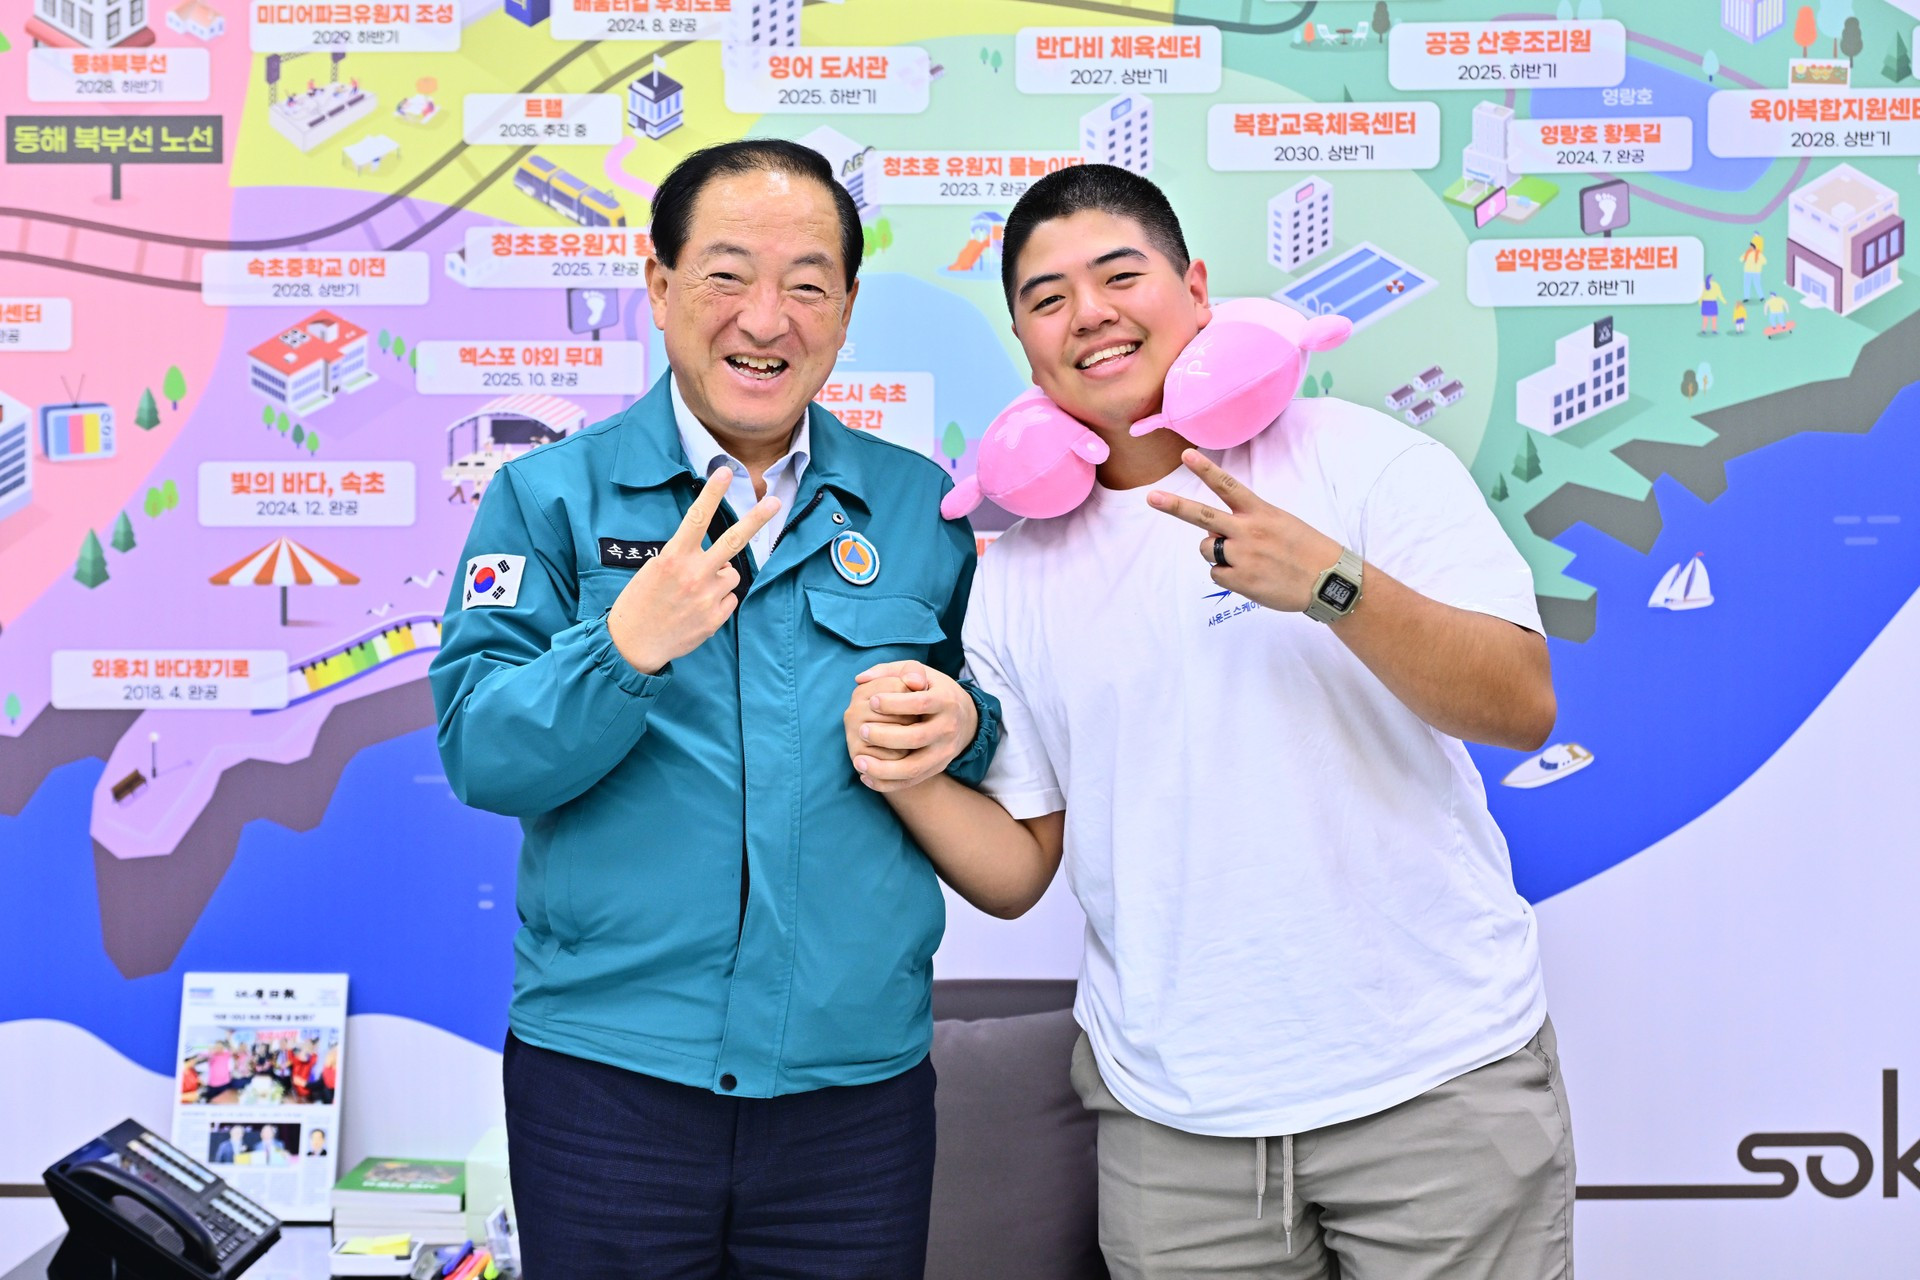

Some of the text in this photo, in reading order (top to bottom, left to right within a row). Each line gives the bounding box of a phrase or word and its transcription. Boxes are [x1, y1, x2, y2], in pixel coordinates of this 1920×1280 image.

[257, 3, 454, 25] 미디어파크유원지 조성
[606, 17, 648, 33] 2024.
[669, 17, 697, 33] 완공
[312, 29, 399, 45] 2029. 하반기
[1426, 28, 1592, 56] 공공 산후조리원
[1036, 35, 1201, 60] 반다비 체육센터
[71, 53, 168, 75] 동해북부선
[768, 55, 889, 80] 영어 도서관
[1457, 62, 1557, 81] 2025. 하반기
[76, 79, 162, 94] 2028. 하반기
[1070, 68, 1168, 86] 2027. 상반기
[778, 88, 877, 105] 2025. 하반기
[1601, 88, 1654, 106] 영랑호
[525, 98, 563, 119] 트램
[499, 123, 587, 138] 2035. 추진 중
[1233, 111, 1417, 137] 복합교육체육센터
[15, 126, 213, 153] 동해 북부선 노선
[1540, 123, 1662, 145] 영랑호 황톳길
[1790, 130, 1891, 148] 2028. 상반기
[1273, 144, 1374, 162] 2030. 상반기
[1556, 150, 1599, 165] 2024.
[1616, 148, 1645, 164] 완공
[883, 156, 940, 177] 청초호
[946, 156, 1003, 177] 유원지
[939, 182, 982, 197] 2023.
[492, 233, 627, 257] 청초호유원지
[247, 257, 387, 278] 속초중학교 이전
[1495, 245, 1678, 273] 설악명상문화센터
[552, 262, 593, 277] 2025.
[612, 262, 639, 277] 완공
[272, 283, 359, 298] 2028. 상반기
[1536, 279, 1635, 298] 2027. 하반기
[0, 303, 43, 324] 센터
[458, 346, 603, 367] 엑스포 야외 무대
[482, 372, 578, 387] 2025. 10. 완공
[869, 383, 907, 403] 속초
[231, 471, 385, 497] 빛의 바다, 속초
[256, 500, 358, 516] 2024. 12. 완공
[1208, 609, 1233, 627] 사운드
[92, 658, 249, 679] 외옹치 바다향기로
[123, 685, 164, 701] 2018.
[188, 684, 218, 701] 완공
